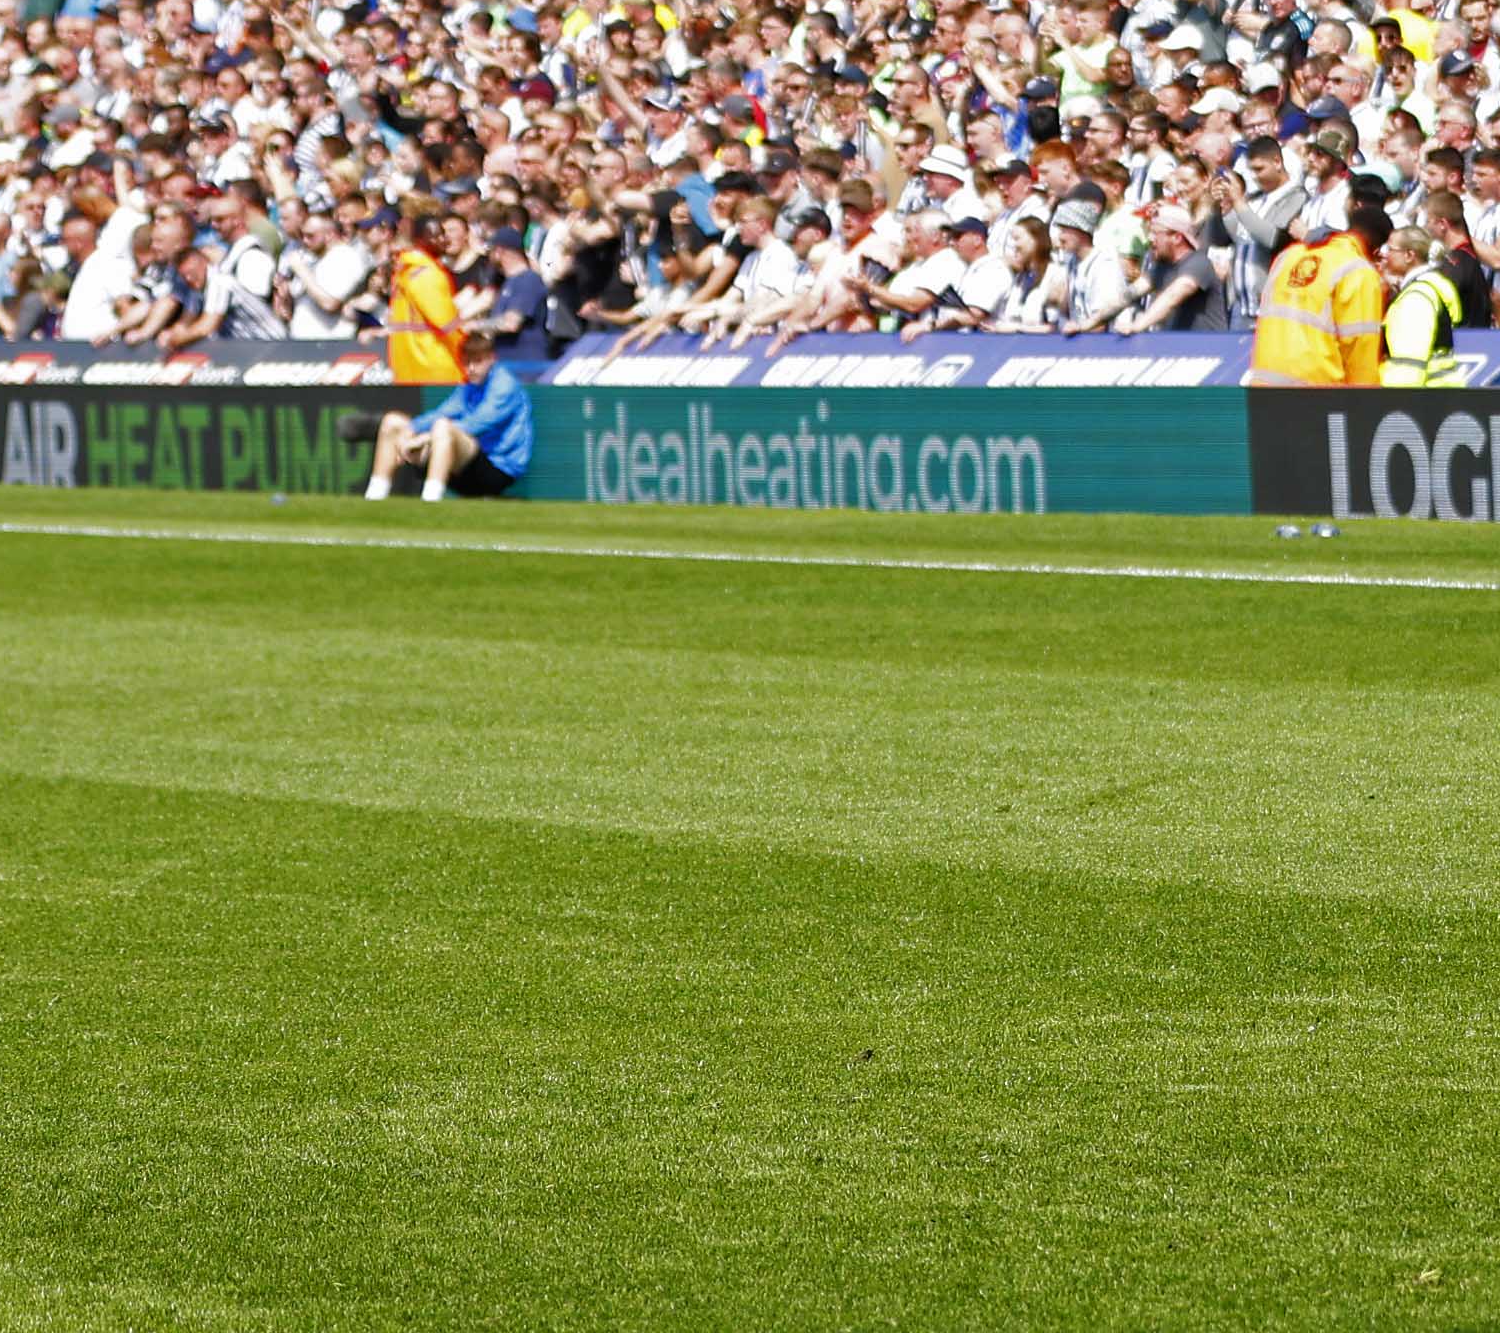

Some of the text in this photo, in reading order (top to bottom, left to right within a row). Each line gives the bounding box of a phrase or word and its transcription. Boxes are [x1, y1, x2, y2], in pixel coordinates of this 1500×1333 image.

[3, 400, 78, 489] AIR
[85, 400, 212, 493] HEAT
[220, 403, 371, 499] PUMP
[583, 397, 1045, 515] idealheating.com
